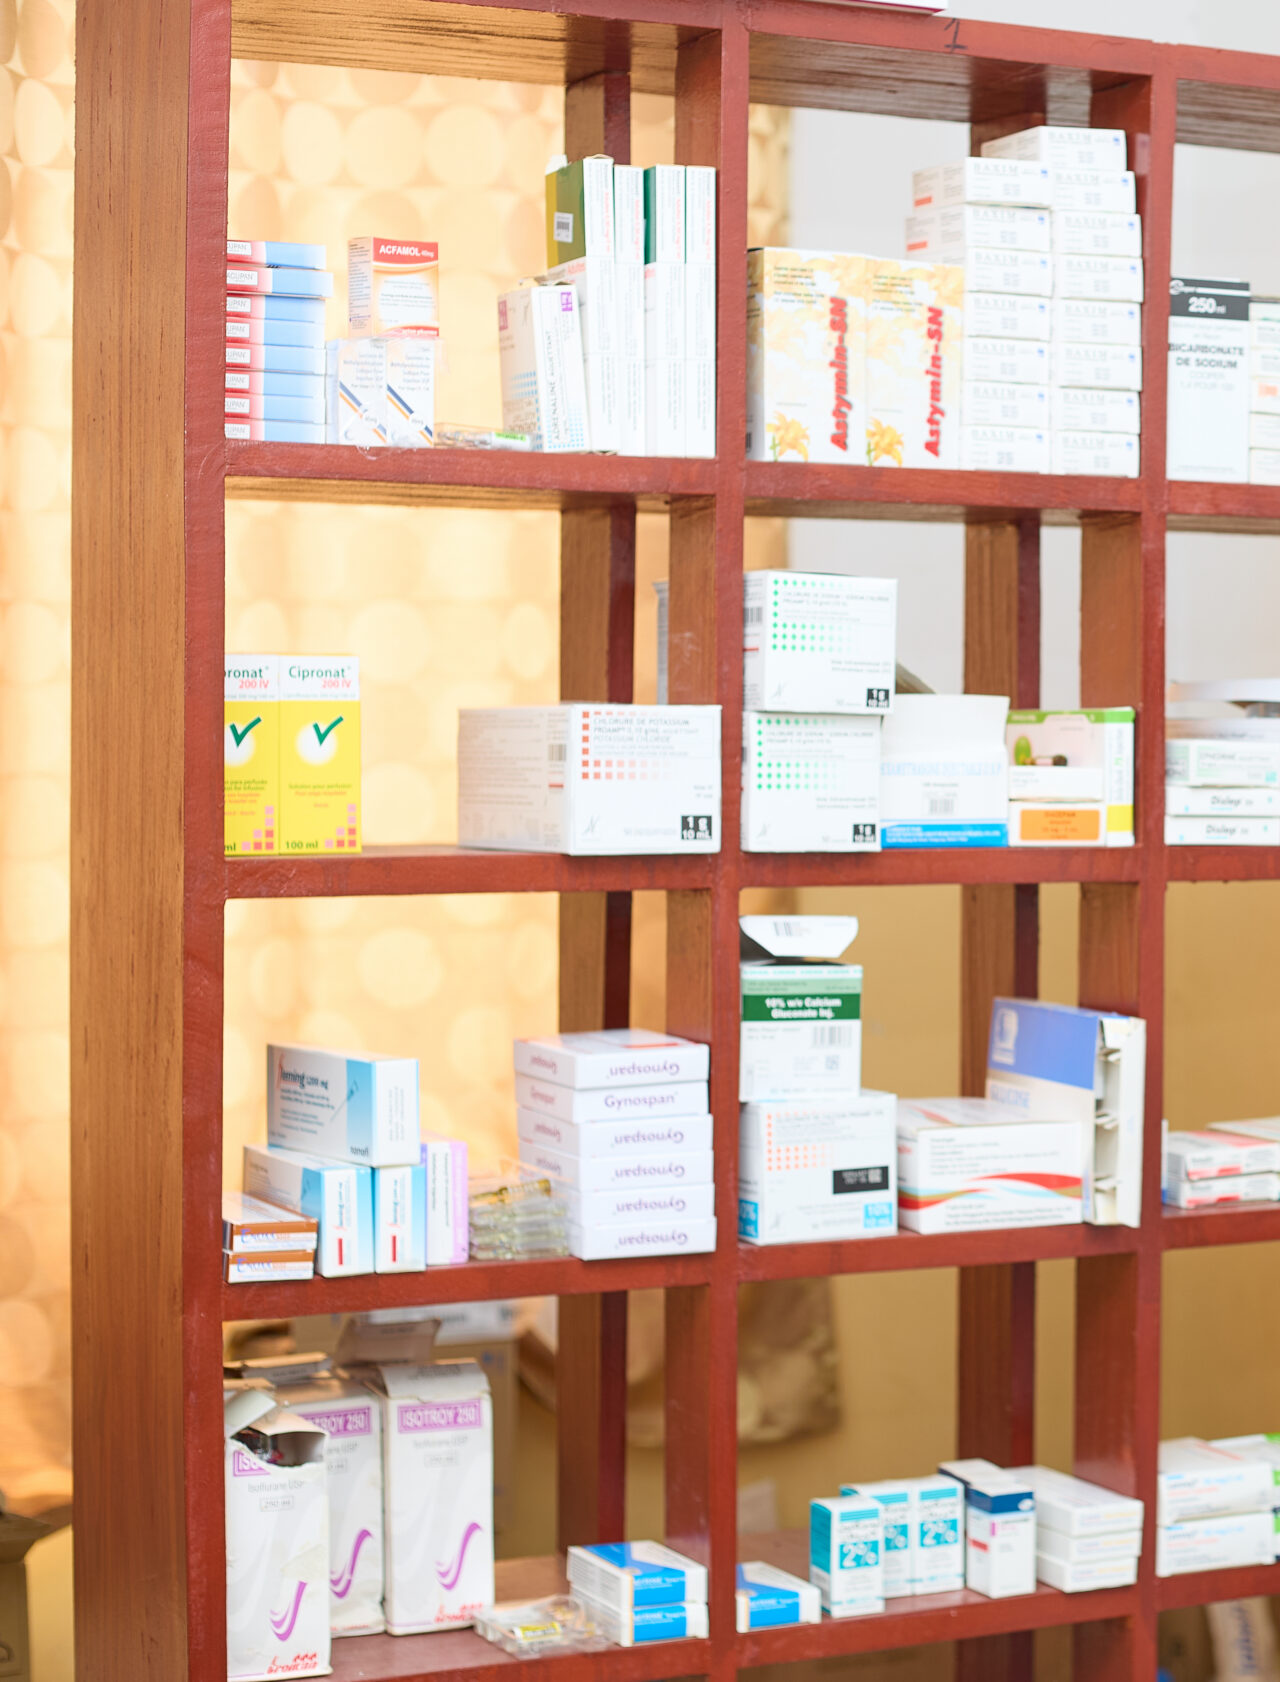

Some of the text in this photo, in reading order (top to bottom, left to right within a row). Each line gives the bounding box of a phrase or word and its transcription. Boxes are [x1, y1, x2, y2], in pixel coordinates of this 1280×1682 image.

[379, 245, 421, 256] ACFAMOL
[1188, 296, 1217, 314] 250
[1175, 357, 1238, 369] DE SODIUM
[828, 296, 854, 451] Astymin-SN
[924, 305, 946, 459] Astymin-SN
[225, 666, 264, 679] ronat
[288, 665, 345, 681] Cipronat
[258, 679, 270, 688] IV
[341, 680, 352, 688] IV
[286, 840, 304, 850] 100
[804, 997, 842, 1008] Calcium
[771, 1008, 818, 1019] Gluconate
[609, 1060, 680, 1076] Gynospan
[603, 1093, 676, 1110] Gynospan
[614, 1128, 685, 1145] Gynospan
[614, 1162, 686, 1178] Gynospan
[616, 1196, 687, 1212] Gynospan
[618, 1229, 689, 1246] Gynospan
[347, 1415, 365, 1428] 250
[402, 1405, 476, 1427] ISOTROY 250
[842, 1543, 878, 1567] 2%
